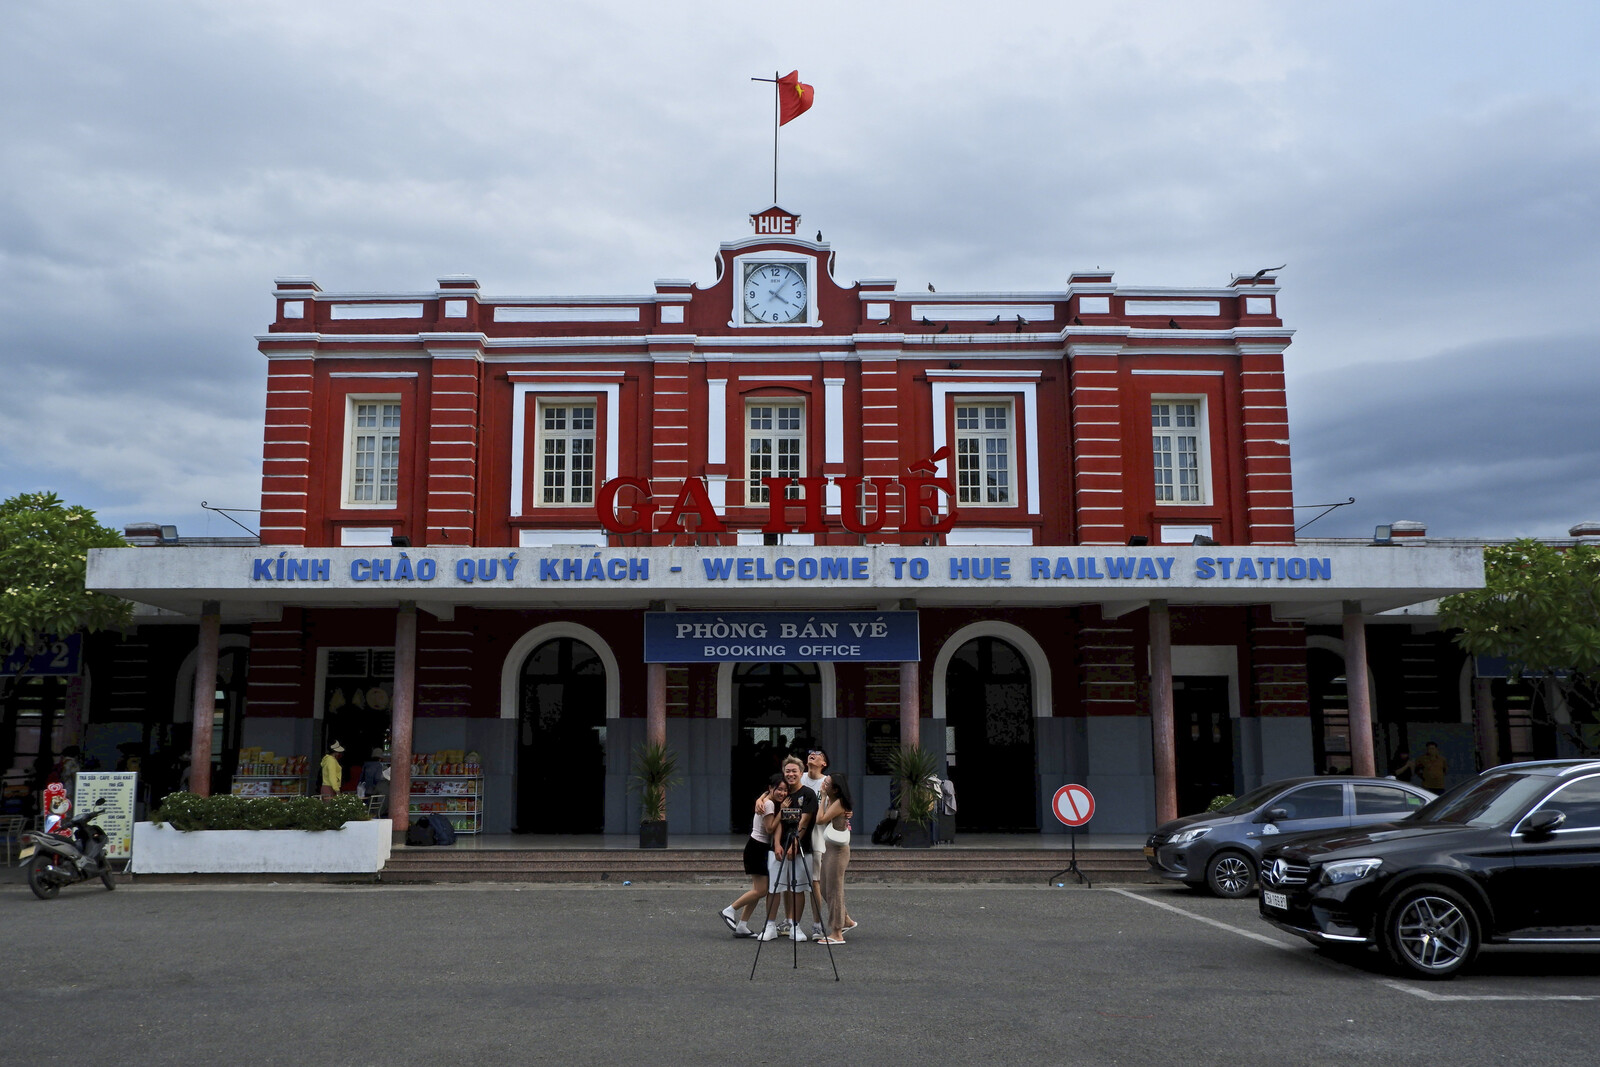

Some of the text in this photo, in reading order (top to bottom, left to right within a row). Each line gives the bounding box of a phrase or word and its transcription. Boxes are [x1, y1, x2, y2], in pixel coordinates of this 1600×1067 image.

[758, 216, 792, 233] HUE
[770, 268, 780, 277] 12
[749, 290, 756, 299] 9
[795, 290, 802, 299] 3
[772, 313, 779, 322] 6
[597, 446, 958, 533] GA HUẾ
[253, 552, 331, 581] KÍNH
[350, 552, 436, 581] CHÀO
[456, 552, 520, 583] QUÝ
[539, 552, 649, 581] KHÁCH
[702, 557, 869, 580] WELCOME
[890, 557, 929, 579] TO
[950, 557, 1011, 580] HUE
[1030, 557, 1175, 580] RAILWAY
[1196, 557, 1332, 580] STATION
[675, 617, 888, 639] PHÒNG BÁN VÉ
[704, 645, 861, 657] BOOKING OFFICE
